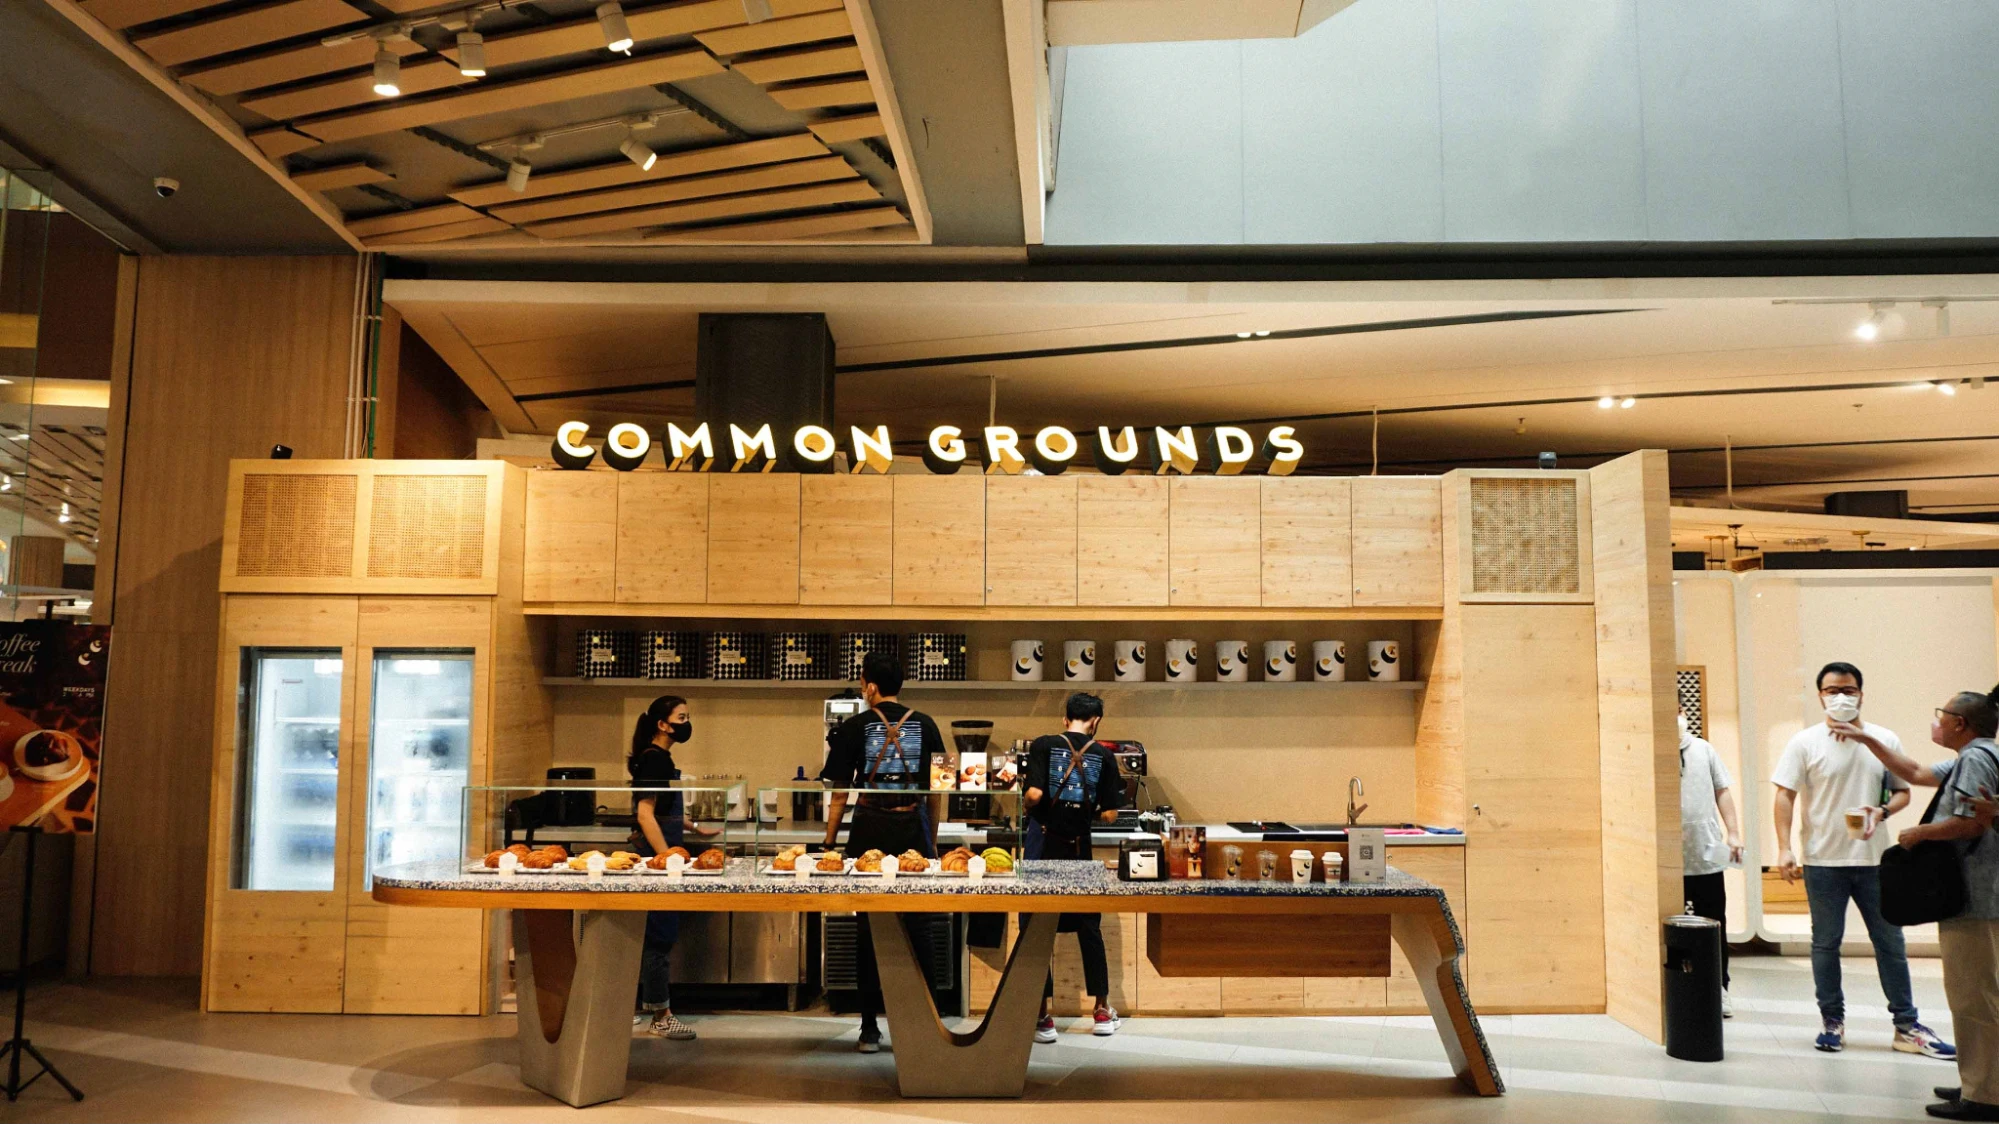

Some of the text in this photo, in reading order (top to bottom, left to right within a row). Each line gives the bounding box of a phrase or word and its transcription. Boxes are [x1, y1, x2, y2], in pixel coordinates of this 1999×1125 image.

[554, 420, 1305, 467] COMMON GROUNDS
[0, 633, 41, 657] offee
